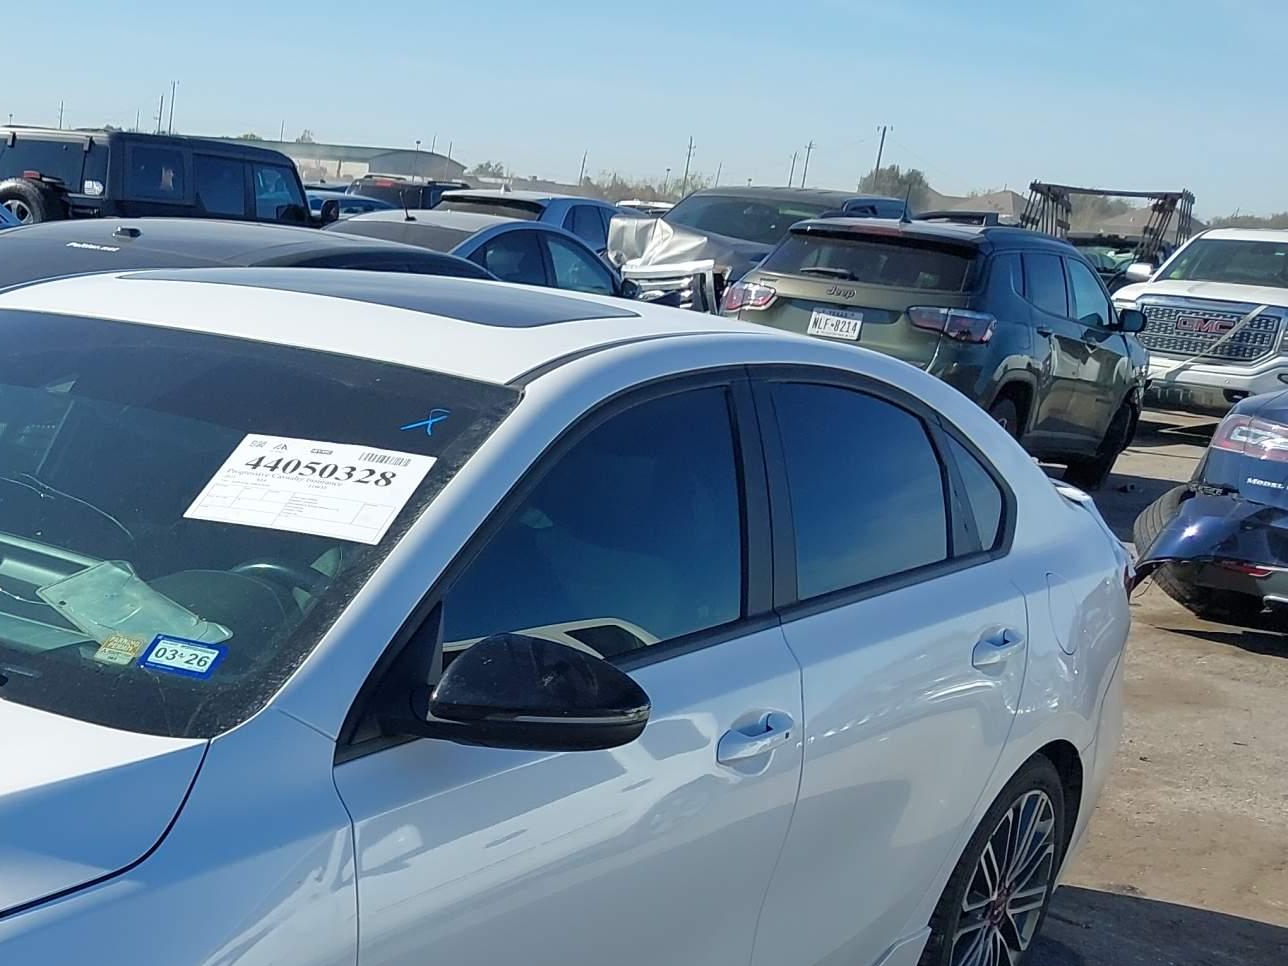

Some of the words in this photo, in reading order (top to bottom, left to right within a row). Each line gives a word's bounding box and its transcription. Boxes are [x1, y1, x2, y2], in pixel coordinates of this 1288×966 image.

[826, 285, 857, 300] Jeep
[1176, 317, 1236, 335] GMC
[245, 455, 397, 487] 44050328
[154, 647, 179, 661] 03
[183, 653, 211, 668] 26
